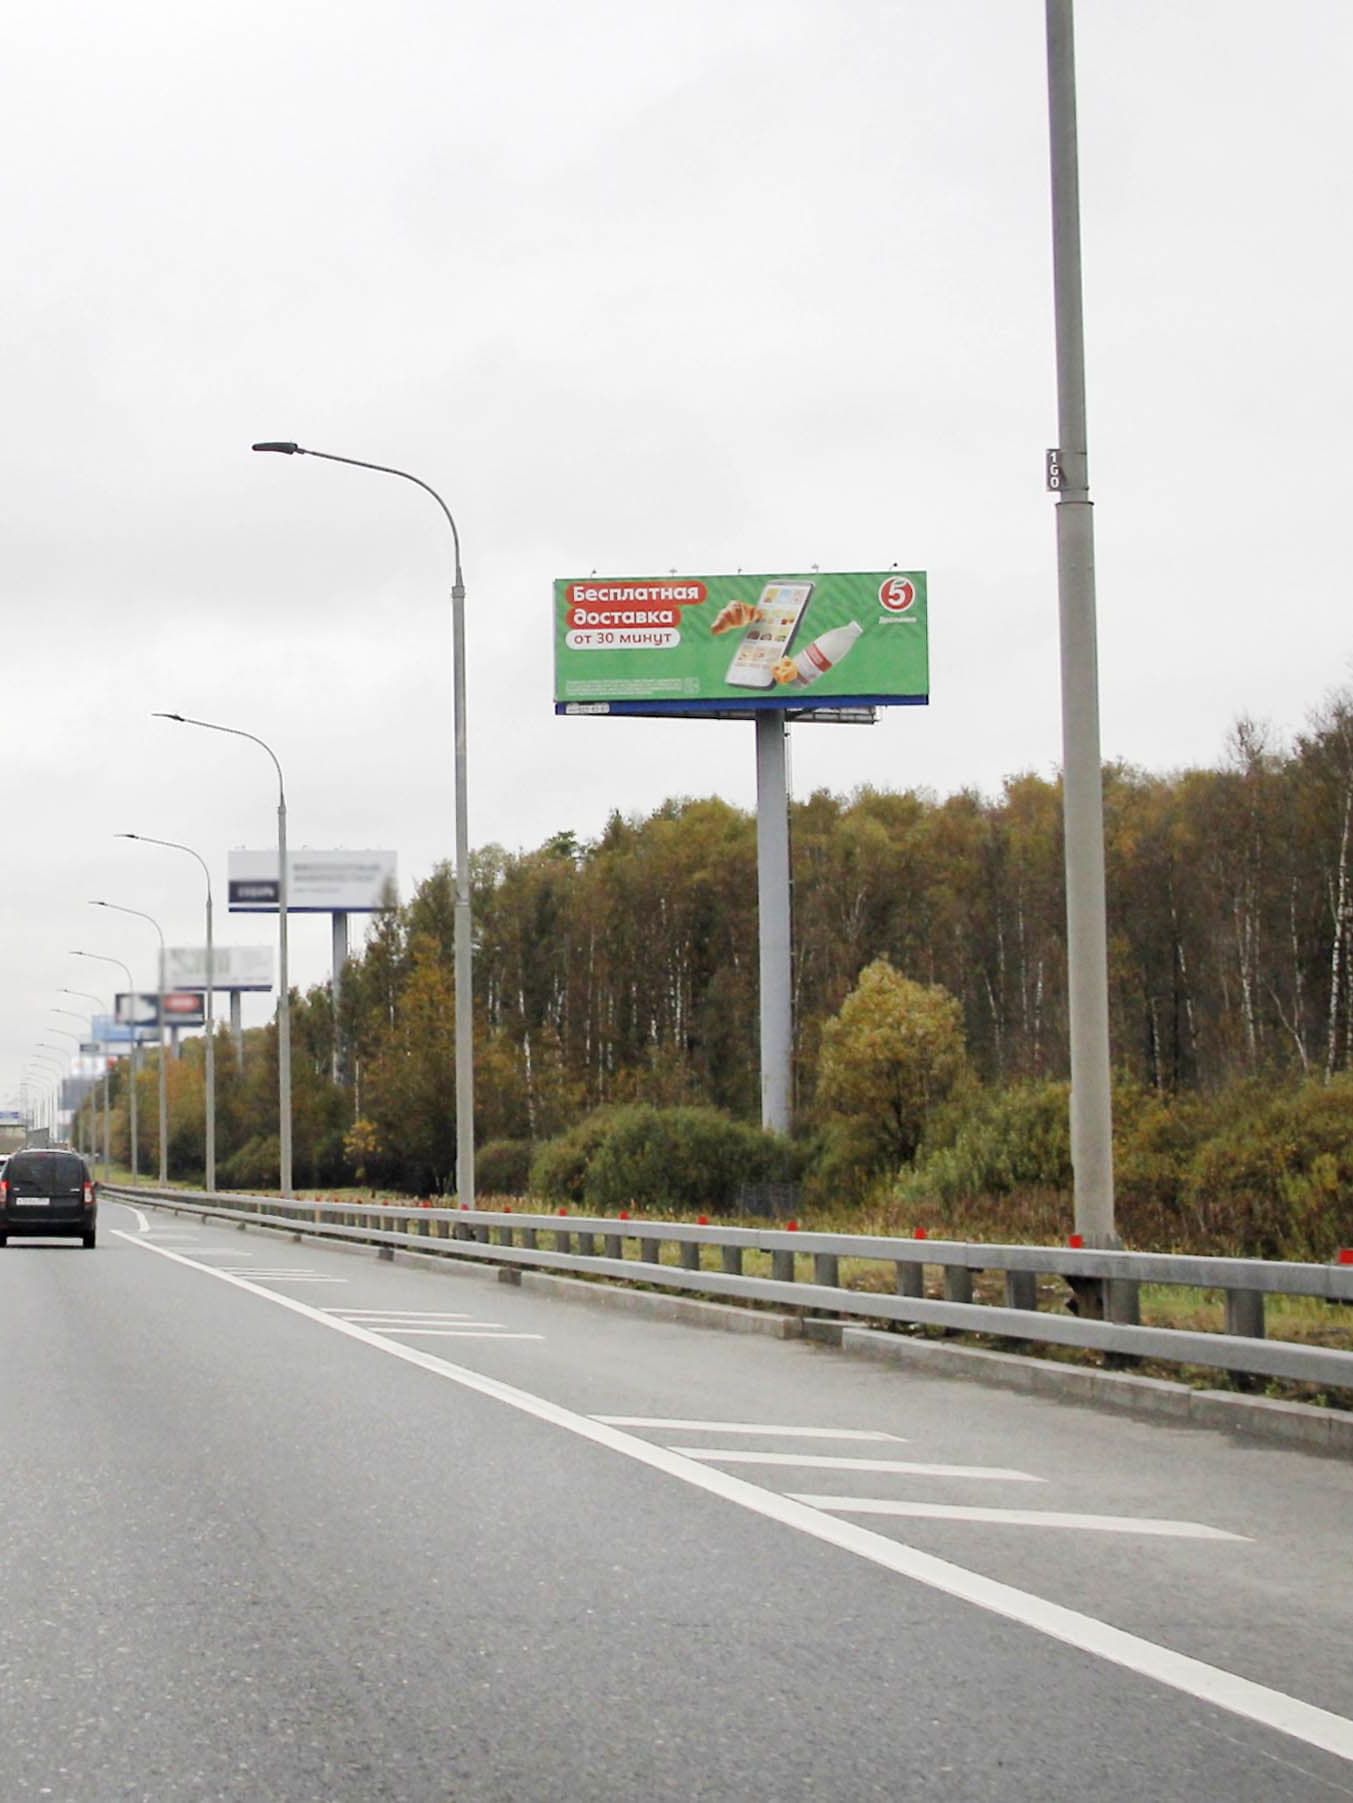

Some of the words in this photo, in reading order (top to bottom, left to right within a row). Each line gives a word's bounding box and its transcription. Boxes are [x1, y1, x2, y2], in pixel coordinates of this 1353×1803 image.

[573, 586, 699, 602] Бесплатная
[573, 608, 673, 625] доставка
[574, 634, 592, 645] от
[597, 632, 614, 644] 30
[619, 633, 672, 645] минут
